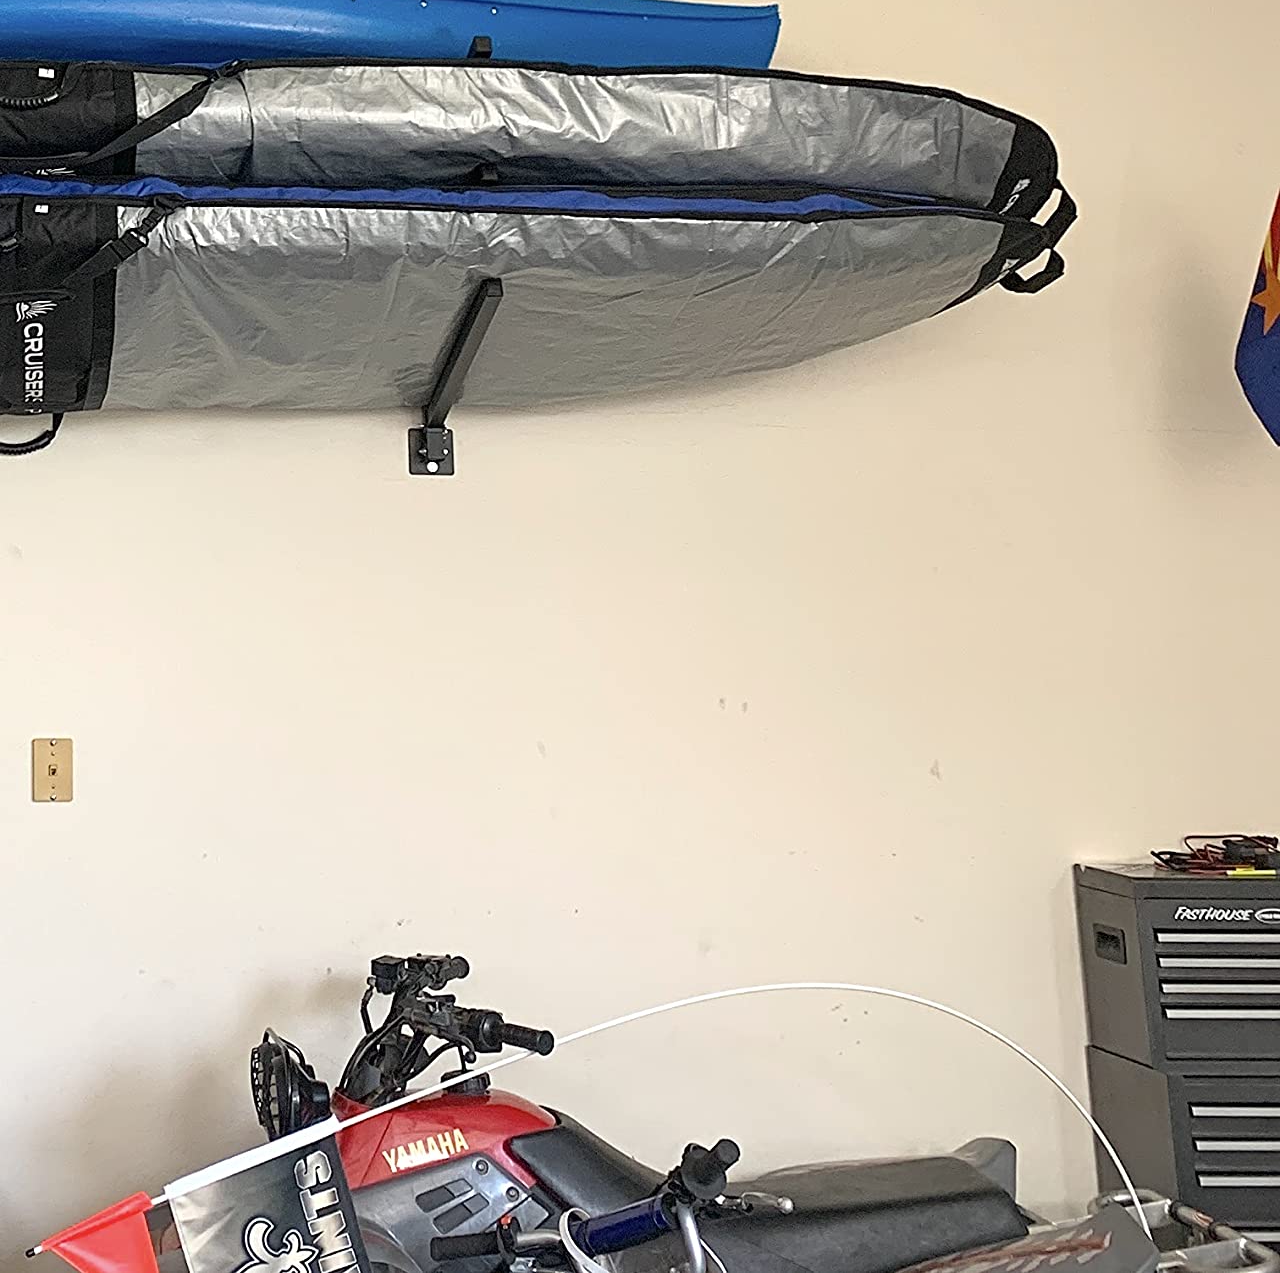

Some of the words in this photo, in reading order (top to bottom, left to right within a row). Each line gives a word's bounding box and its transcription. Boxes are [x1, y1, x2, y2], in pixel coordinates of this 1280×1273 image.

[23, 322, 44, 398] CRUISER
[1174, 906, 1254, 921] FASTHOUSE
[381, 1128, 470, 1173] YAMAHA
[293, 1150, 361, 1273] INTS
